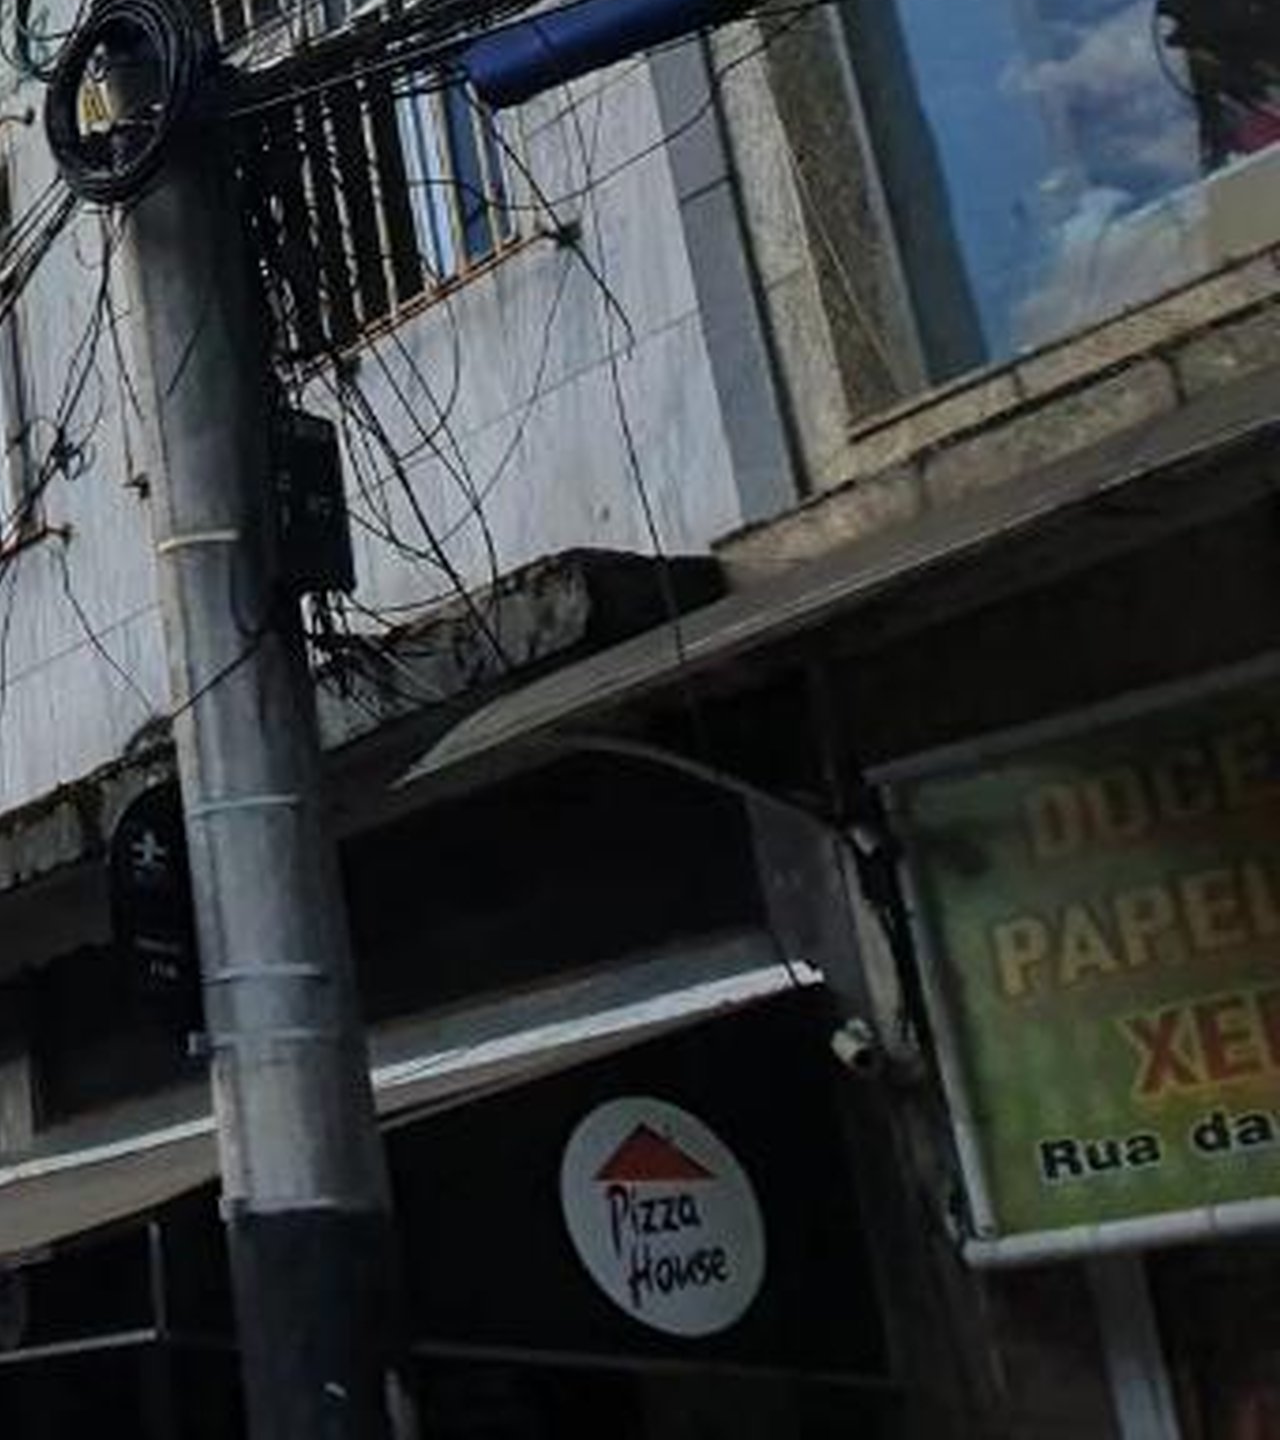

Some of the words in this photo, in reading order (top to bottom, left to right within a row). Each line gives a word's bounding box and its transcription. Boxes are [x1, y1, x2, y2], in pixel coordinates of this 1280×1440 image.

[1040, 1132, 1162, 1180] Rua
[1193, 1111, 1273, 1153] da
[606, 1184, 702, 1260] Pizza
[629, 1247, 730, 1308] House
